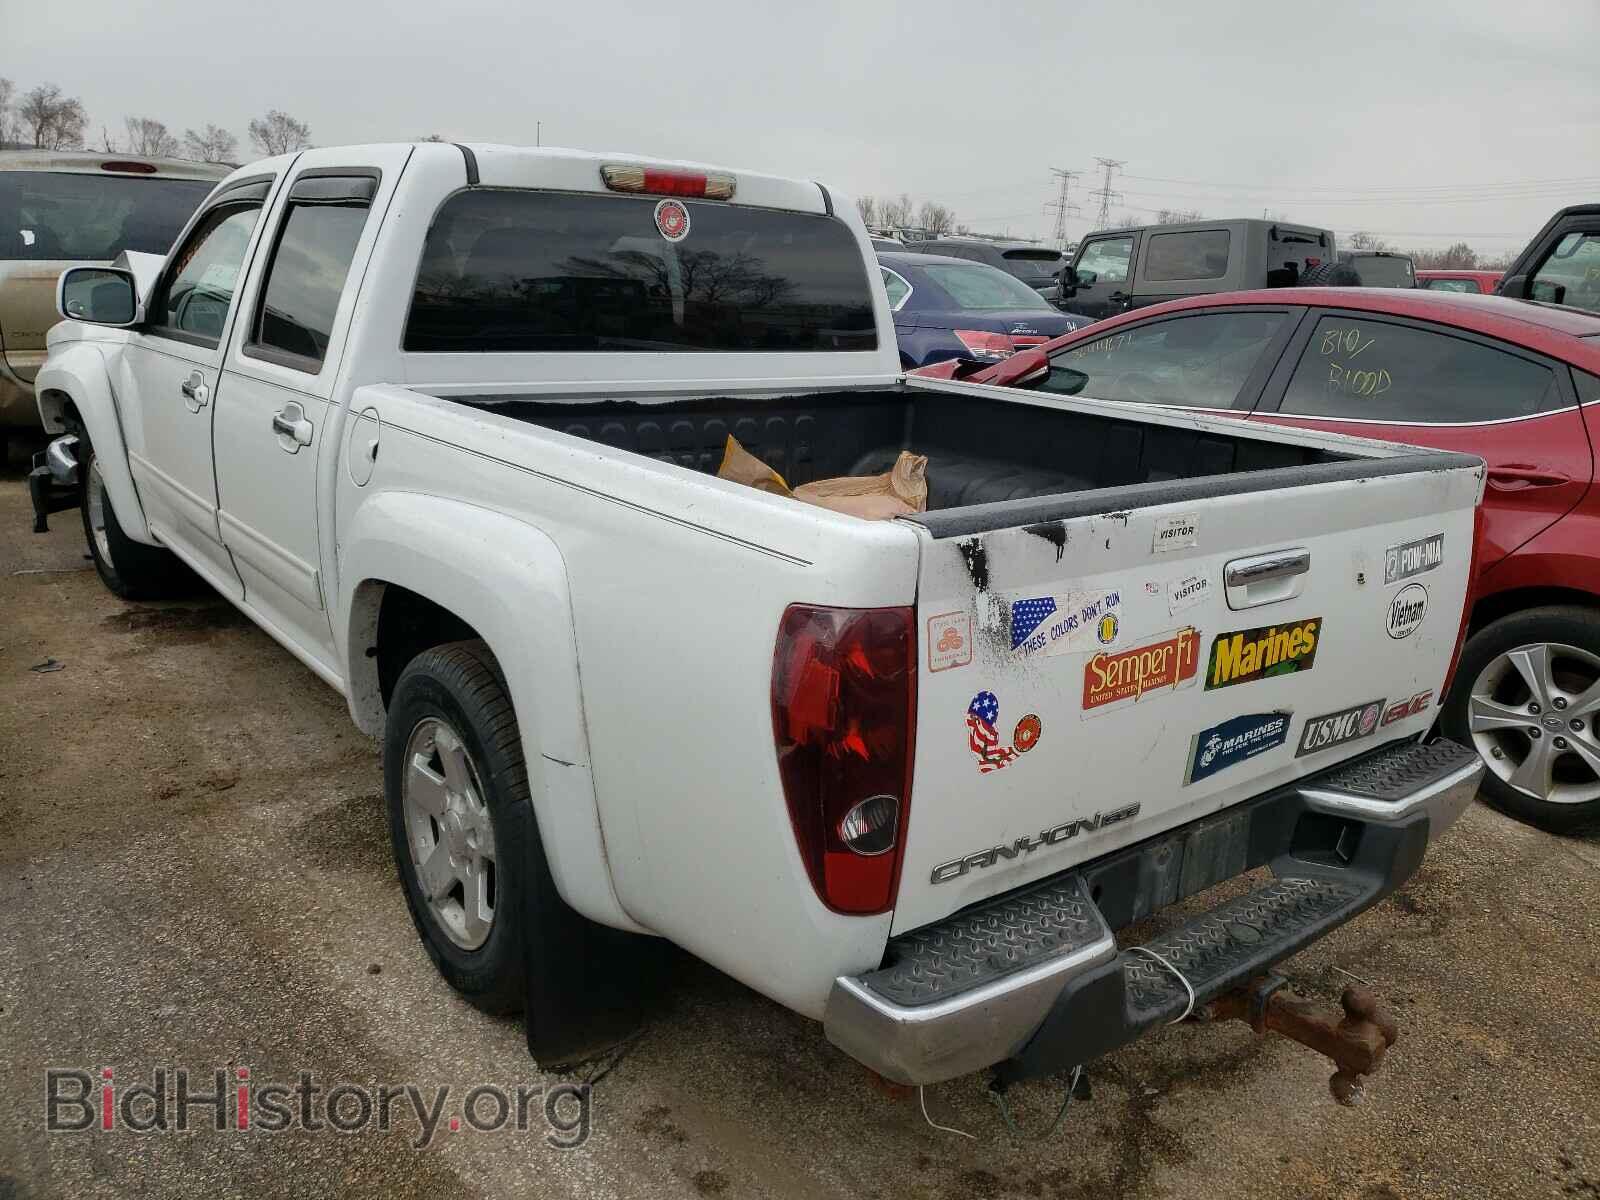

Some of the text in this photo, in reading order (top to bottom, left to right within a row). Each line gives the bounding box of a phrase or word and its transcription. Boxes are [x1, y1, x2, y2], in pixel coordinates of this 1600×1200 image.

[1160, 526, 1194, 539] VISITOR
[1401, 540, 1441, 574] POW-MIA
[1174, 579, 1208, 601] VISITOR
[1022, 631, 1048, 657] THESE
[1050, 614, 1079, 640] COLORS
[1081, 600, 1102, 623] DON'T
[1105, 591, 1120, 609] RUN
[1390, 599, 1424, 629] Vietnam
[1090, 645, 1173, 703] Semper
[1173, 626, 1195, 690] Fi
[1213, 622, 1316, 686] Marines
[1222, 718, 1284, 750] MARINES
[1303, 710, 1362, 750] USMC
[931, 811, 1104, 884] CANYON
